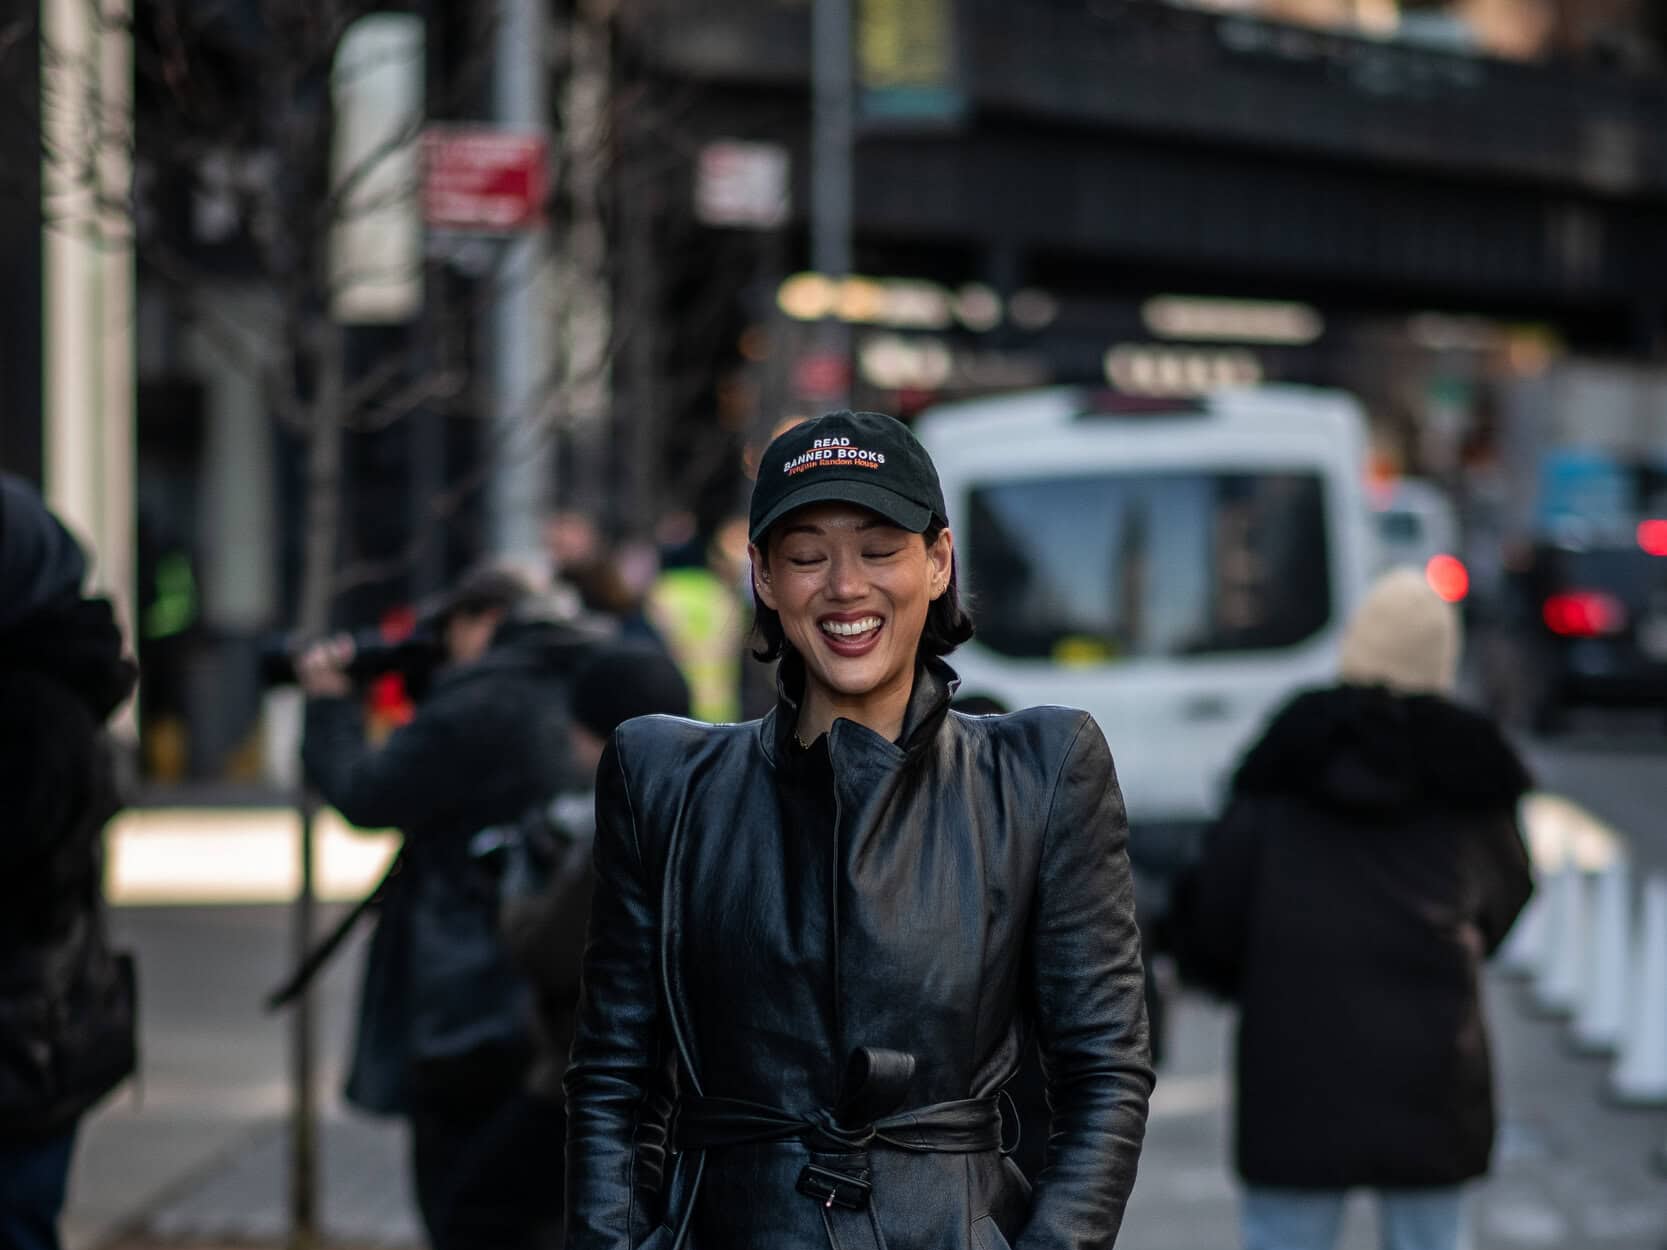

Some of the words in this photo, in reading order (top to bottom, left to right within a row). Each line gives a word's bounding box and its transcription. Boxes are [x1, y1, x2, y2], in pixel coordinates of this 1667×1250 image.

[813, 437, 850, 449] READ
[783, 450, 832, 473] BANNED
[837, 449, 886, 464] BOOKS
[854, 458, 880, 469] House
